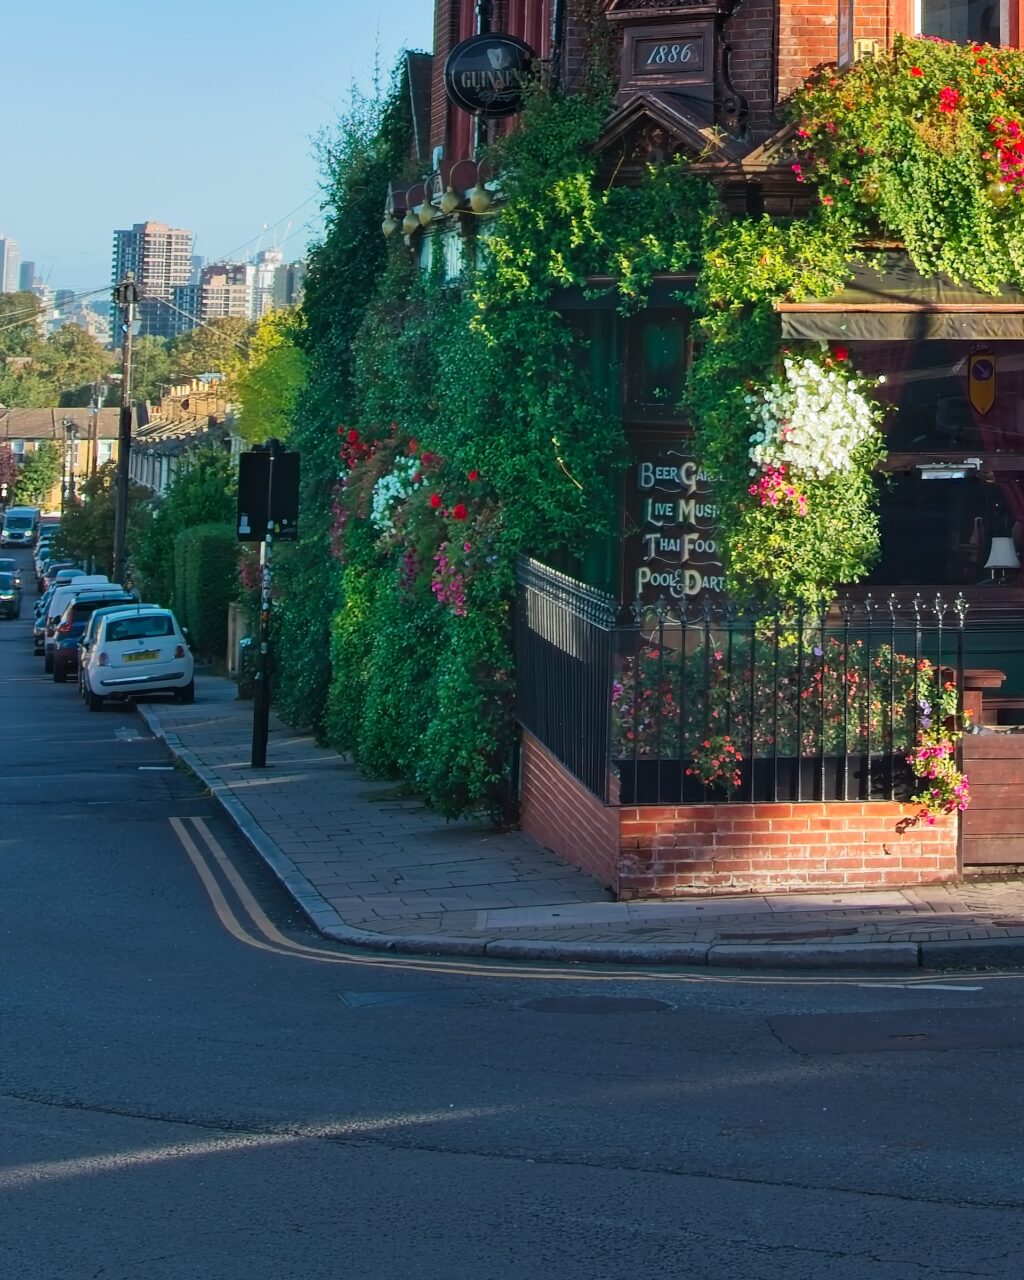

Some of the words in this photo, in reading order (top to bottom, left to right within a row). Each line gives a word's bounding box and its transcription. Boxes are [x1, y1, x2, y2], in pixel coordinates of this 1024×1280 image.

[646, 44, 693, 65] 1886
[640, 462, 680, 487] BEER
[646, 498, 673, 526] LIVE
[678, 499, 720, 525] MUSI
[643, 533, 680, 562] THAI
[680, 533, 716, 564] FOO
[684, 570, 726, 595] DART
